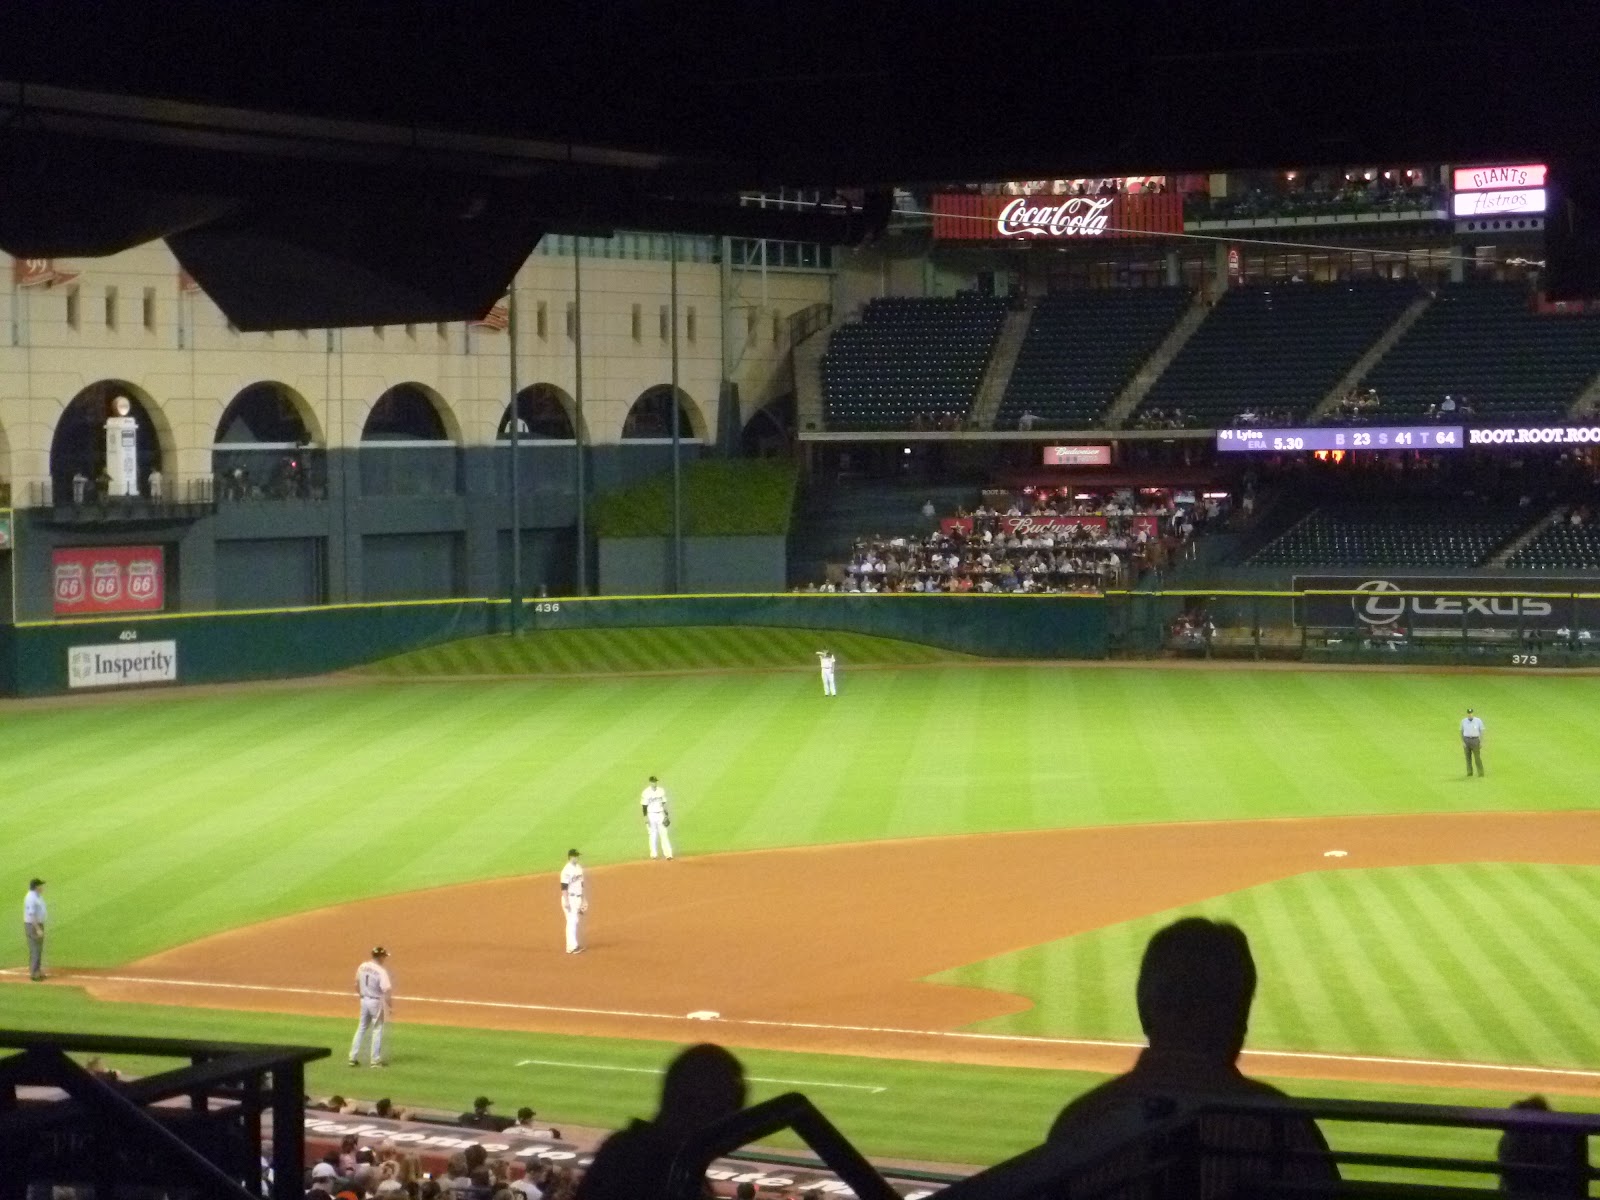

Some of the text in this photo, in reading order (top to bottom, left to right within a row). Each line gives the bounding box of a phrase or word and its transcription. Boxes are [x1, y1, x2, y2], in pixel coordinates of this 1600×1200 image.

[1473, 168, 1528, 188] GIANTS
[1473, 192, 1529, 215] Astros
[998, 197, 1115, 236] Coca-Cola
[1220, 430, 1233, 440] 41
[1248, 437, 1304, 450] ERA 5.30
[1335, 431, 1455, 446] B 23 S 41 T 64
[1008, 517, 1101, 535] Budweier
[60, 576, 151, 596] 66 66 66
[535, 603, 560, 613] 436
[1412, 594, 1552, 616] LEXUS
[119, 630, 137, 640] 404
[95, 650, 173, 679] Insperity
[1512, 654, 1538, 665] 373
